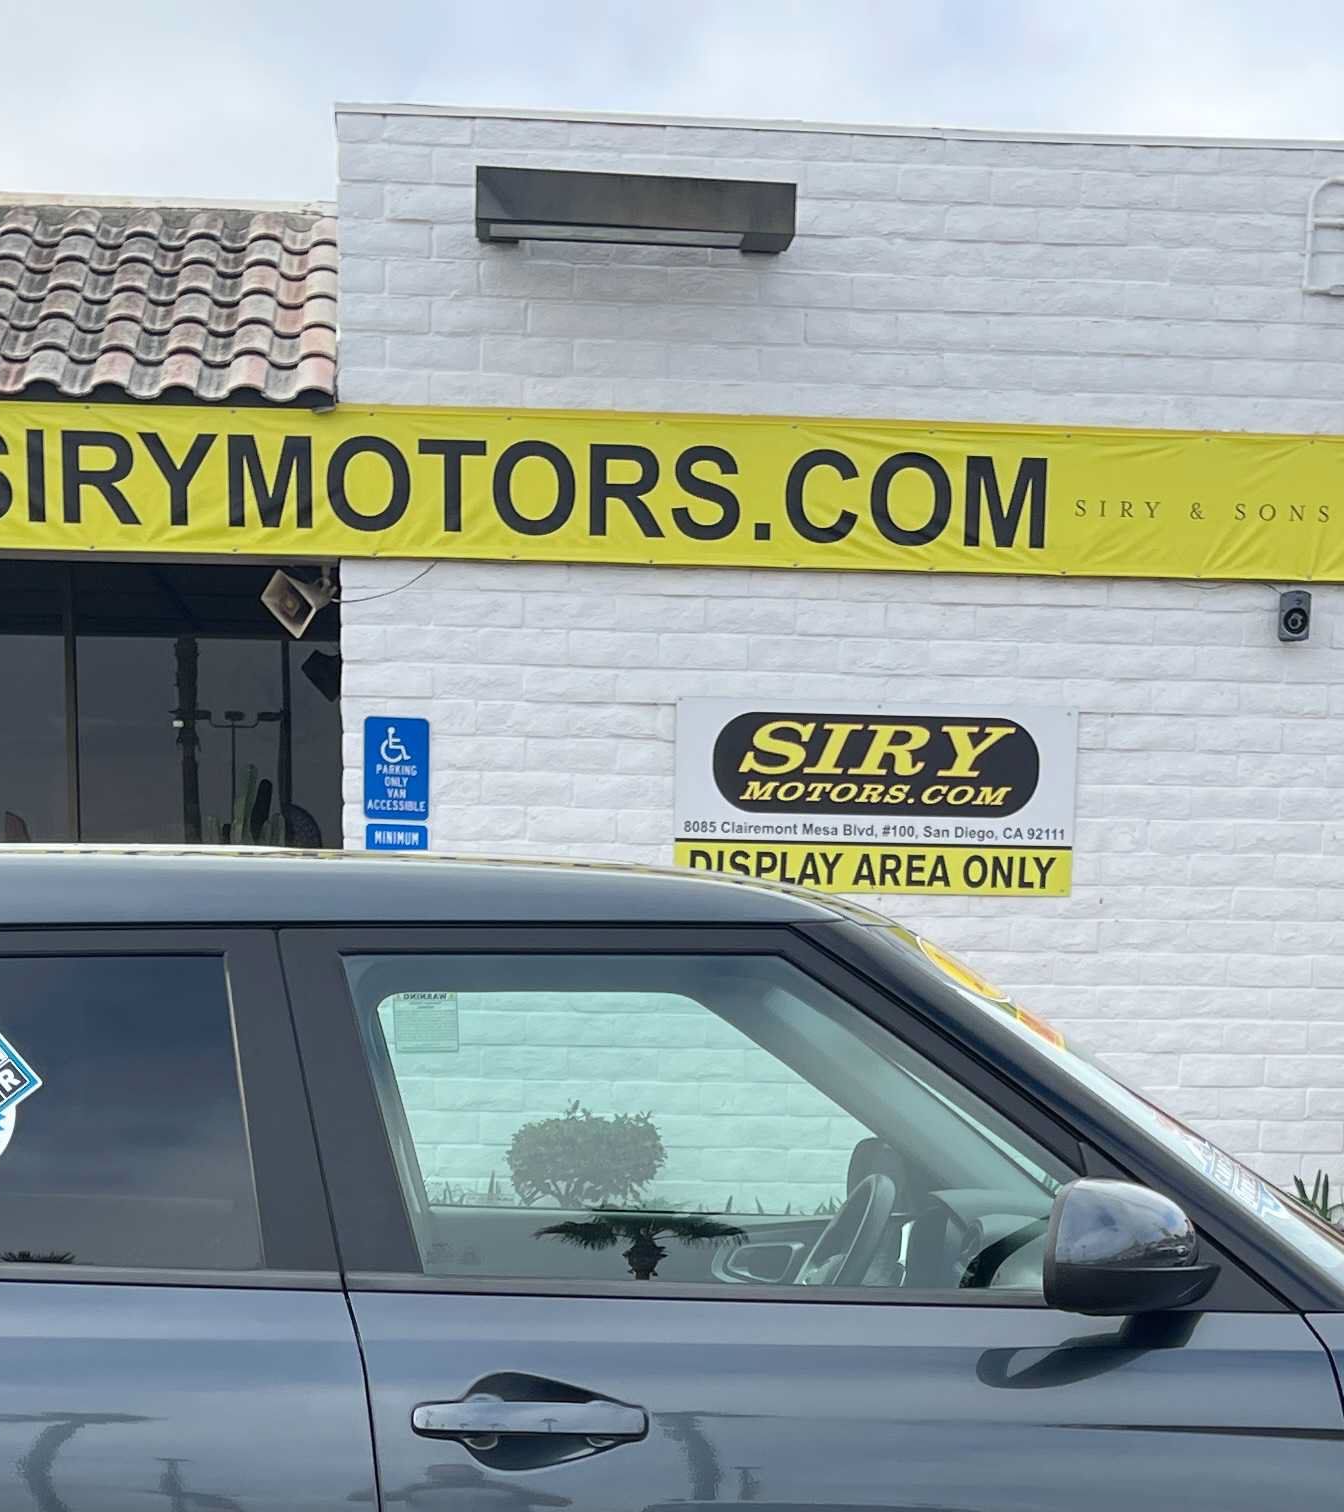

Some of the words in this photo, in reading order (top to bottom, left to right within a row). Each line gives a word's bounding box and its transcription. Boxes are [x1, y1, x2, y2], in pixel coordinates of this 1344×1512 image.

[1074, 499, 1160, 518] SIRY
[1190, 502, 1205, 520] &
[1234, 503, 1330, 523] SONS
[738, 720, 1016, 777] SIRY
[376, 764, 417, 776] PARKING
[384, 777, 408, 787] ONLY
[387, 788, 406, 799] VAN
[739, 781, 1012, 806] MOTORS.COM
[367, 799, 426, 812] ACCESSIBLE
[374, 830, 419, 845] MINIMUM
[684, 821, 716, 833] 8085
[721, 821, 797, 835] Clairemont
[802, 823, 838, 836] Mesa
[843, 824, 877, 838] Blvd,
[882, 825, 918, 839] #100,
[923, 826, 949, 838] San
[955, 826, 998, 841] Diego,
[1003, 828, 1023, 839] CA
[1028, 828, 1064, 840] 92111
[852, 853, 950, 887] AREA
[963, 855, 1056, 889] ONLY
